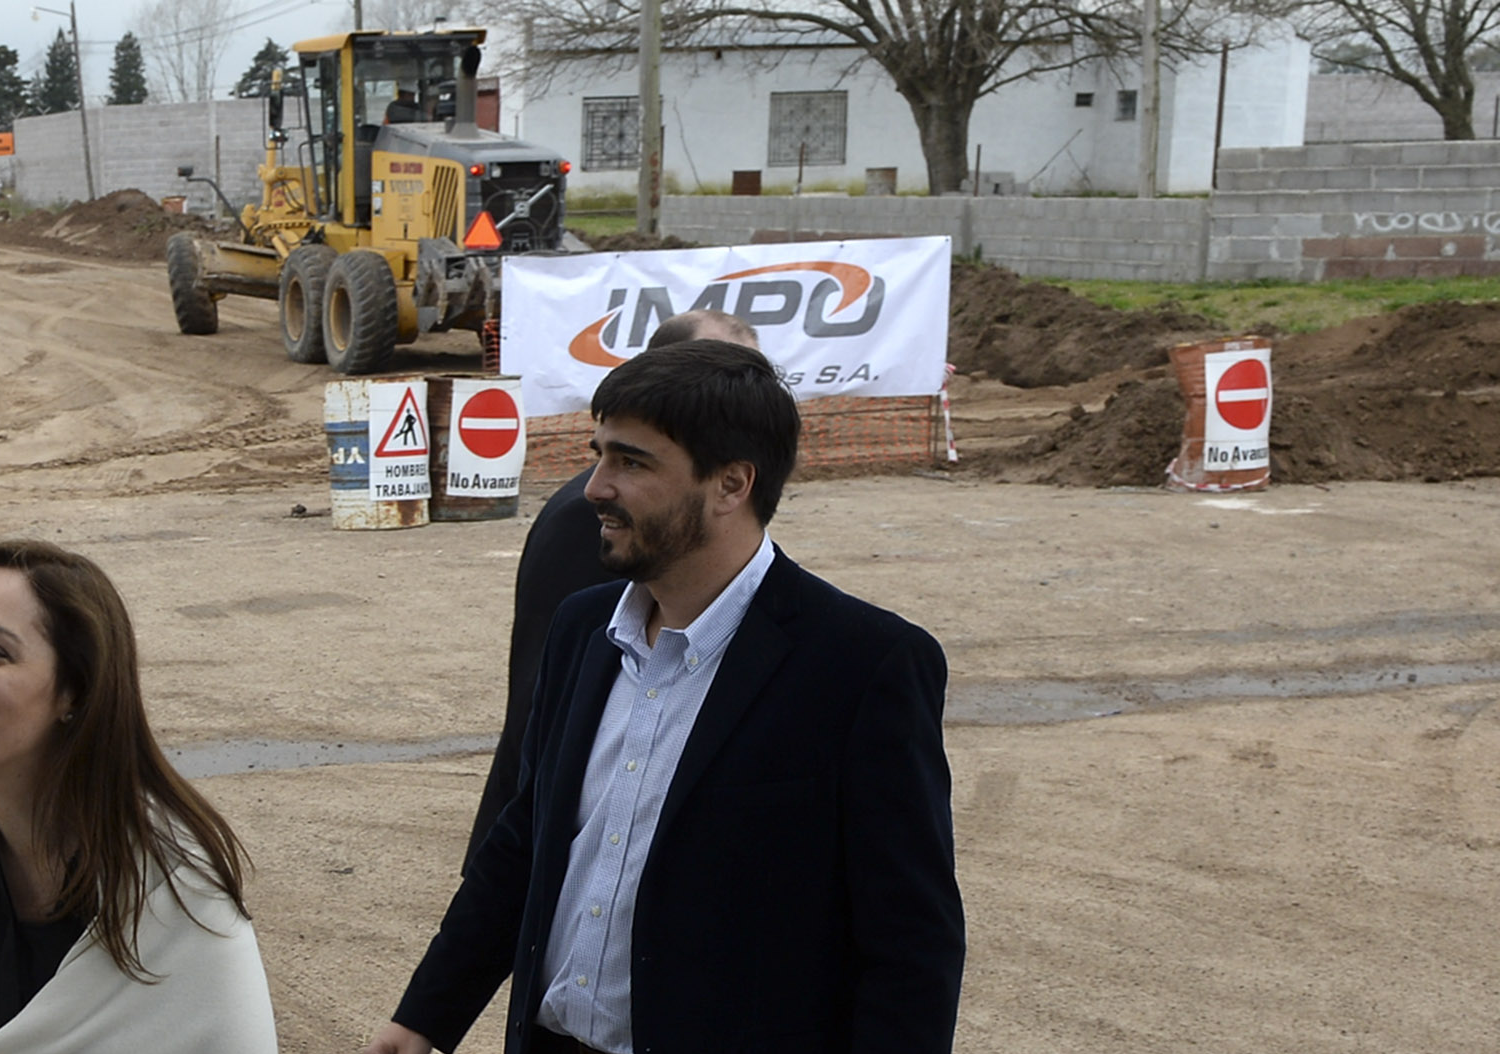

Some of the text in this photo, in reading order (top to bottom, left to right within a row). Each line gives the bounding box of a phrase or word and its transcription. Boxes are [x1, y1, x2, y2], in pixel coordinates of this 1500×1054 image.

[601, 276, 886, 349] IMPO
[815, 363, 879, 384] S.A.
[331, 446, 365, 464] YP
[1208, 447, 1229, 463] No
[450, 472, 469, 489] No
